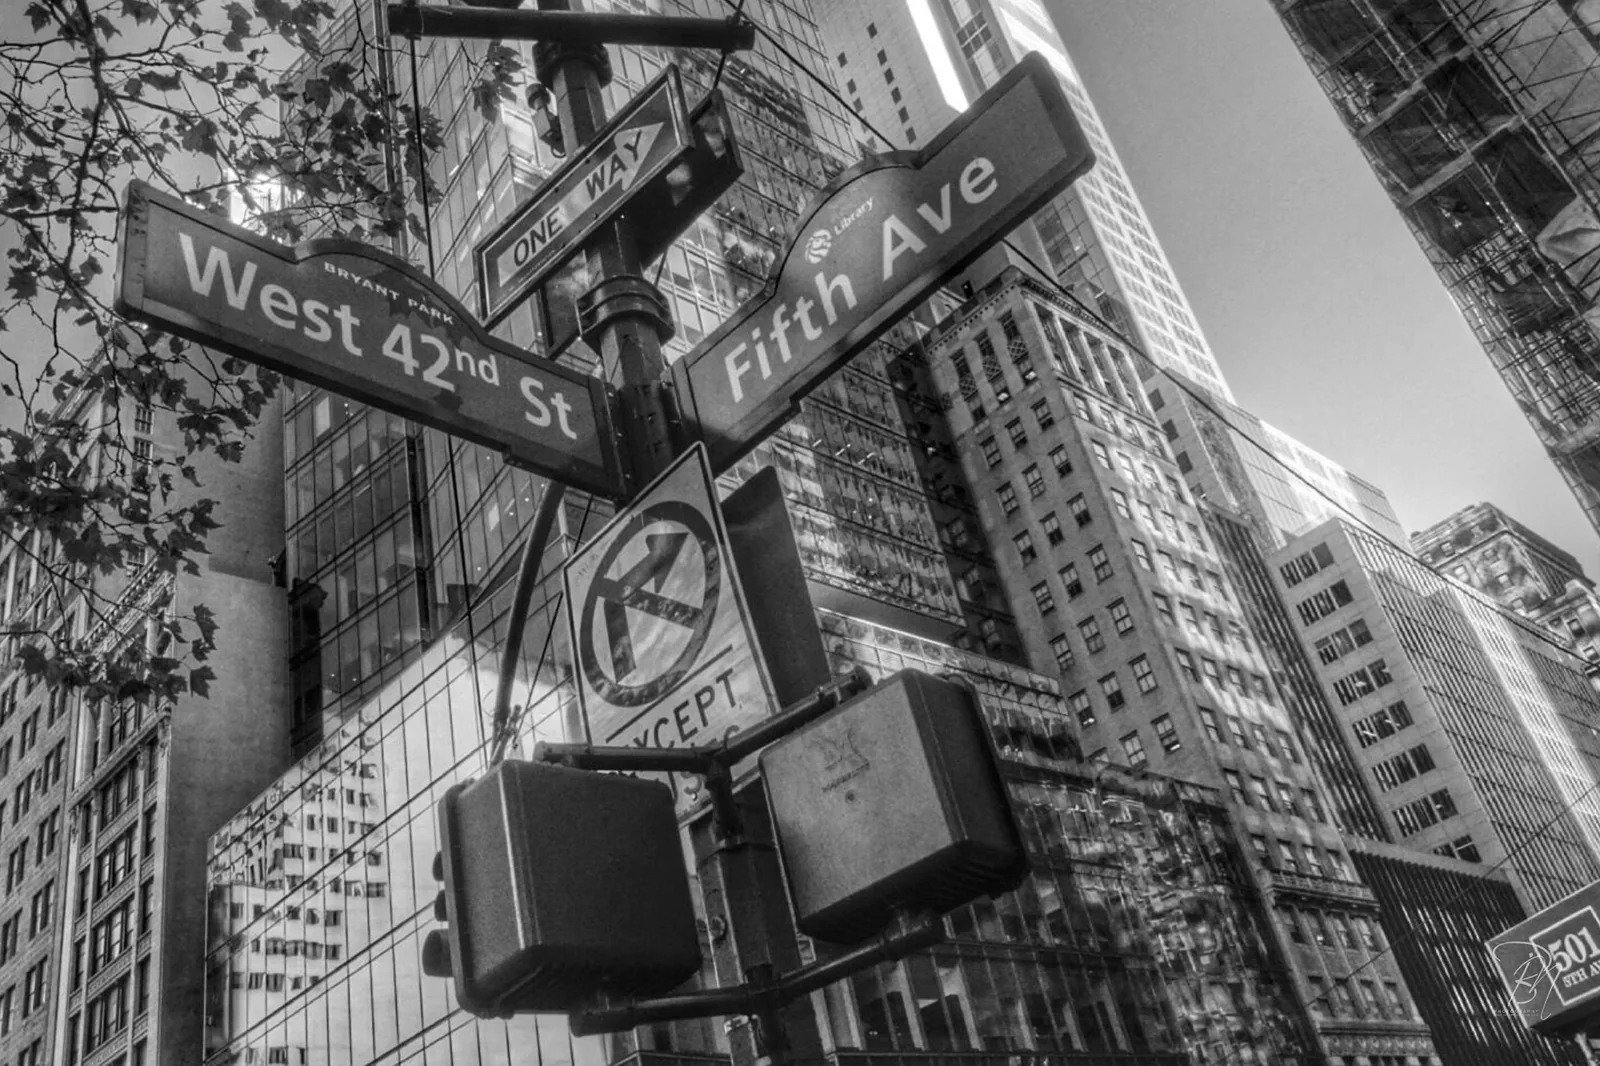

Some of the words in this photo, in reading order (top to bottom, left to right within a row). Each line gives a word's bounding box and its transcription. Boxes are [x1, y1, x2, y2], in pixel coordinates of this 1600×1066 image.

[514, 207, 564, 267] ONE
[586, 130, 642, 201] WAY
[834, 196, 873, 235] Library
[324, 261, 400, 300] BRYANT
[408, 298, 453, 325] PARK
[724, 272, 858, 403] Fifth
[882, 156, 999, 281] Ave
[179, 232, 363, 357] West
[382, 323, 500, 392] 42nd
[520, 376, 578, 440] St
[1548, 926, 1600, 971] 501
[1562, 967, 1589, 988] 5TH
